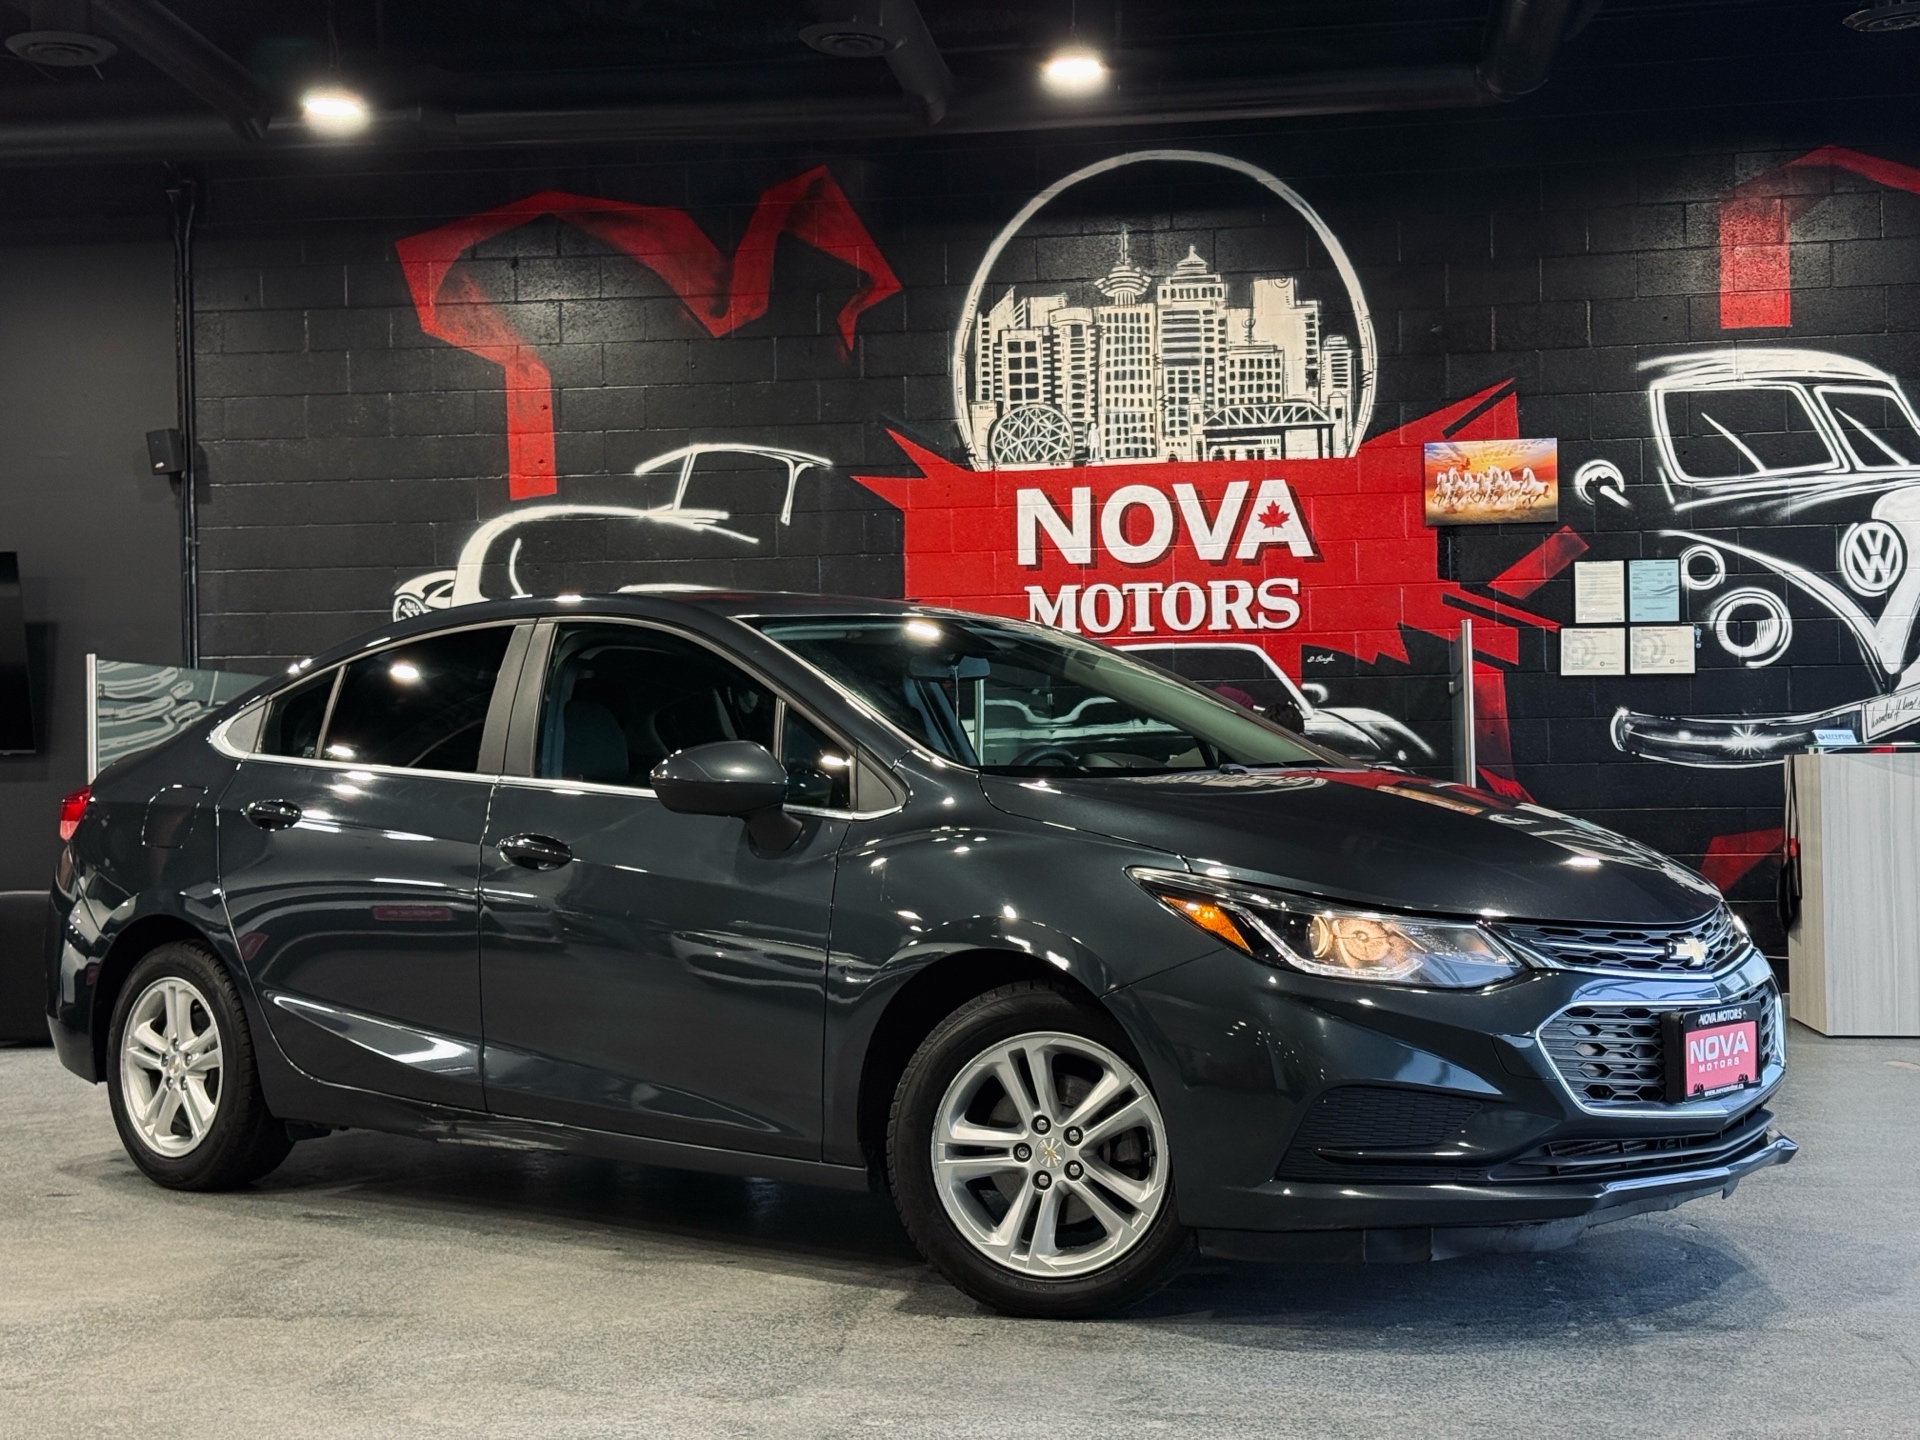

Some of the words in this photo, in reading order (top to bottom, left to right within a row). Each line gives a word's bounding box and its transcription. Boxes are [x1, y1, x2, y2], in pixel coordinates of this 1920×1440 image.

[1017, 479, 1315, 565] NOVA
[1024, 578, 1300, 633] MOTORS
[1698, 1012, 1716, 1026] NOVA
[1717, 1008, 1742, 1022] MOTORS
[1690, 1030, 1749, 1065] NOVA
[1698, 1056, 1740, 1073] MOTORS
